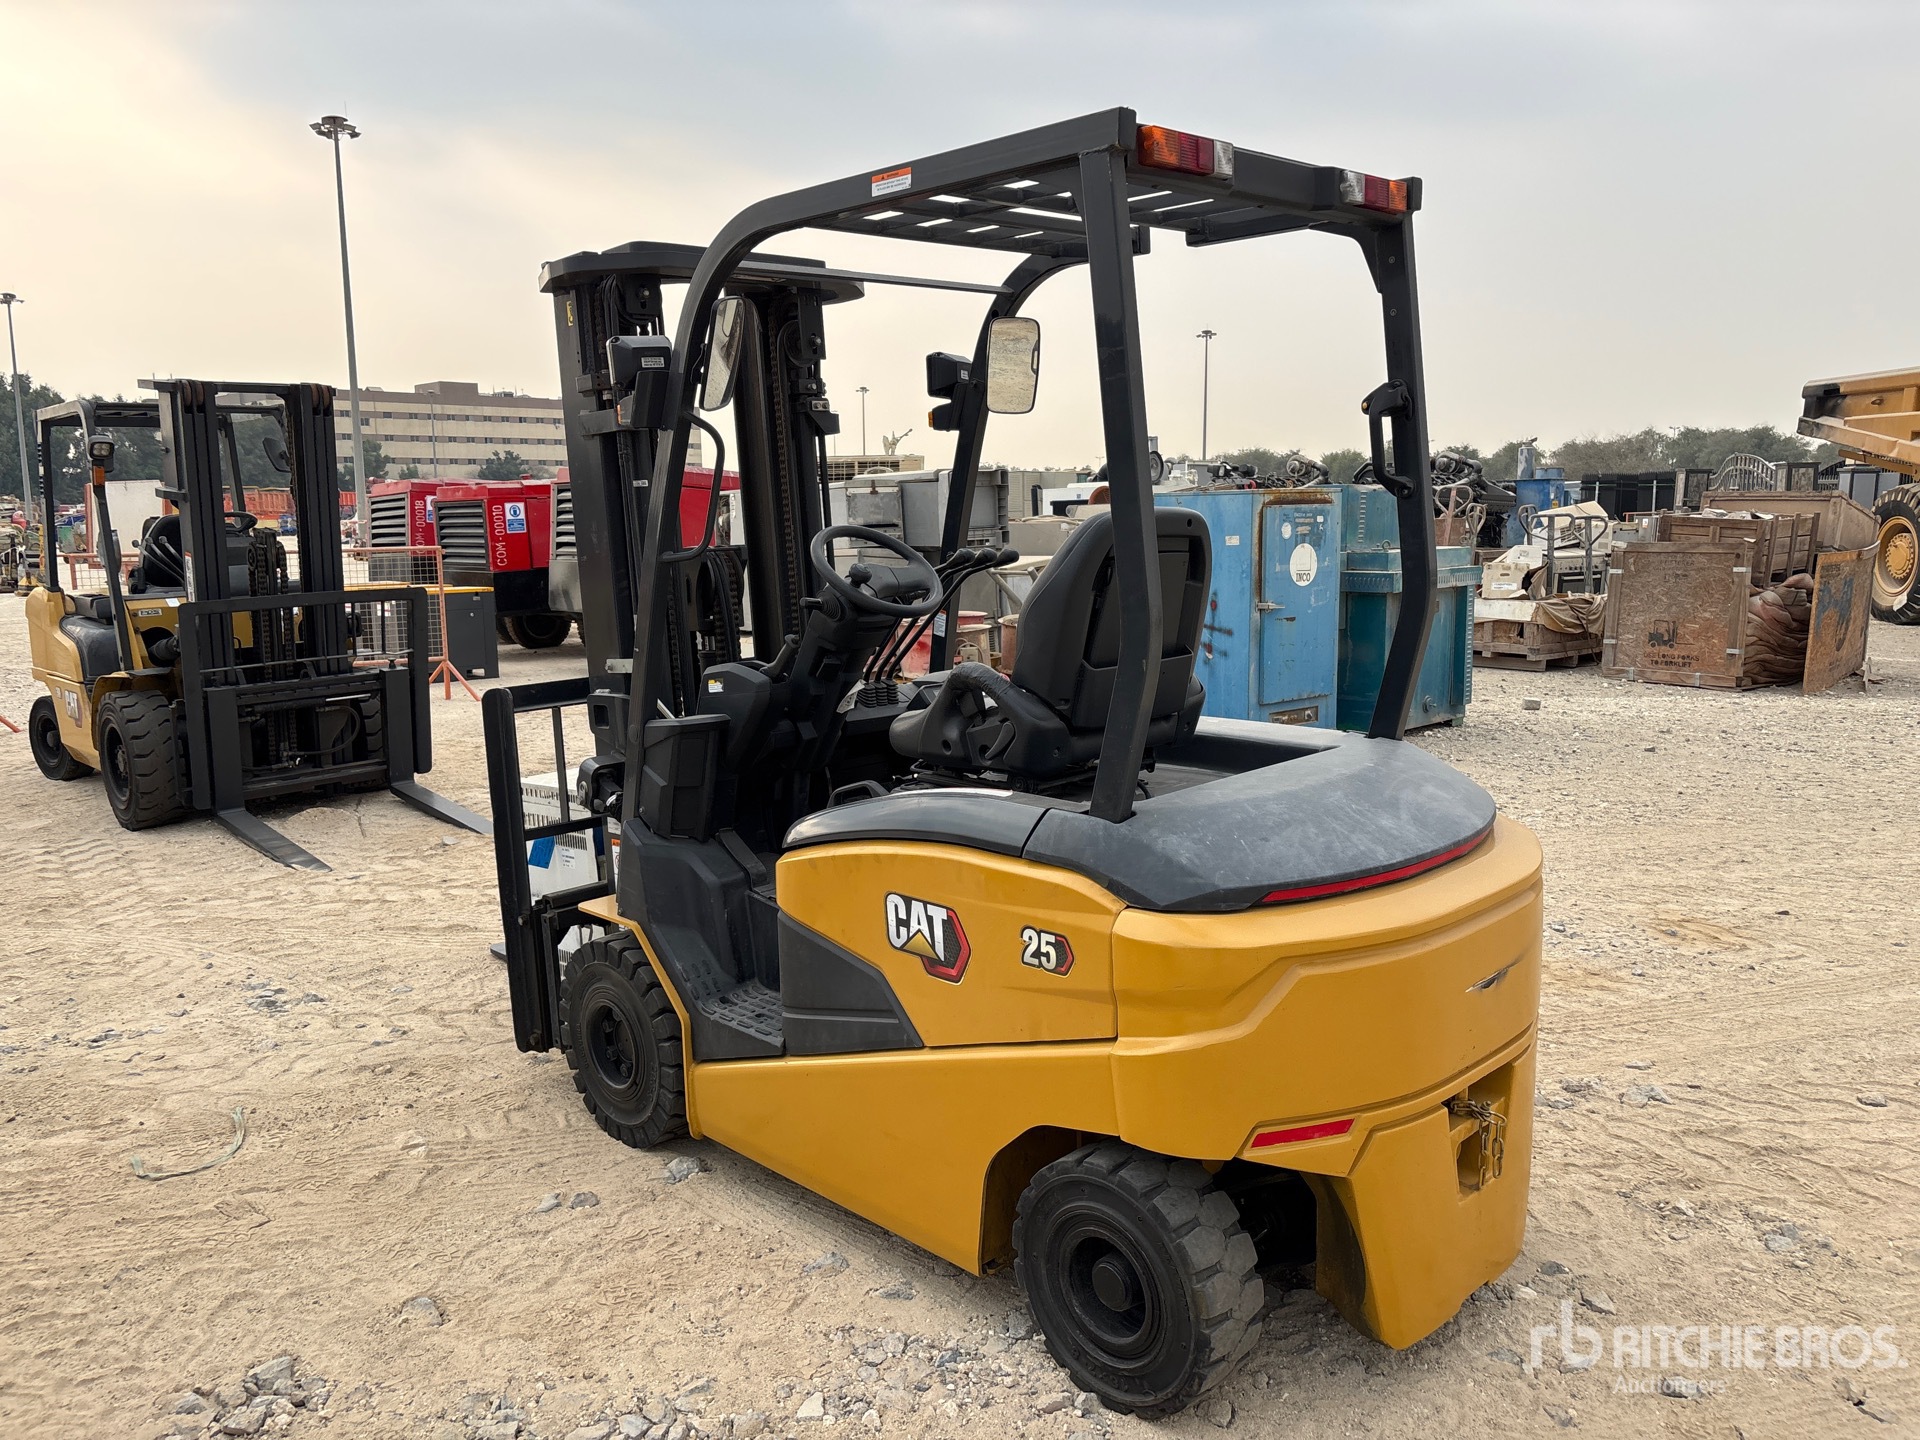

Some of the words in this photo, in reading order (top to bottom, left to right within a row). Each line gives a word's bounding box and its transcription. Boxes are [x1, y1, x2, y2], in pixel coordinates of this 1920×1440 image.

[1660, 660, 1692, 668] FORKLIFT
[1677, 654, 1700, 662] FORKS
[65, 690, 79, 719] CAT
[886, 893, 948, 962] CAT
[1022, 928, 1057, 970] 25
